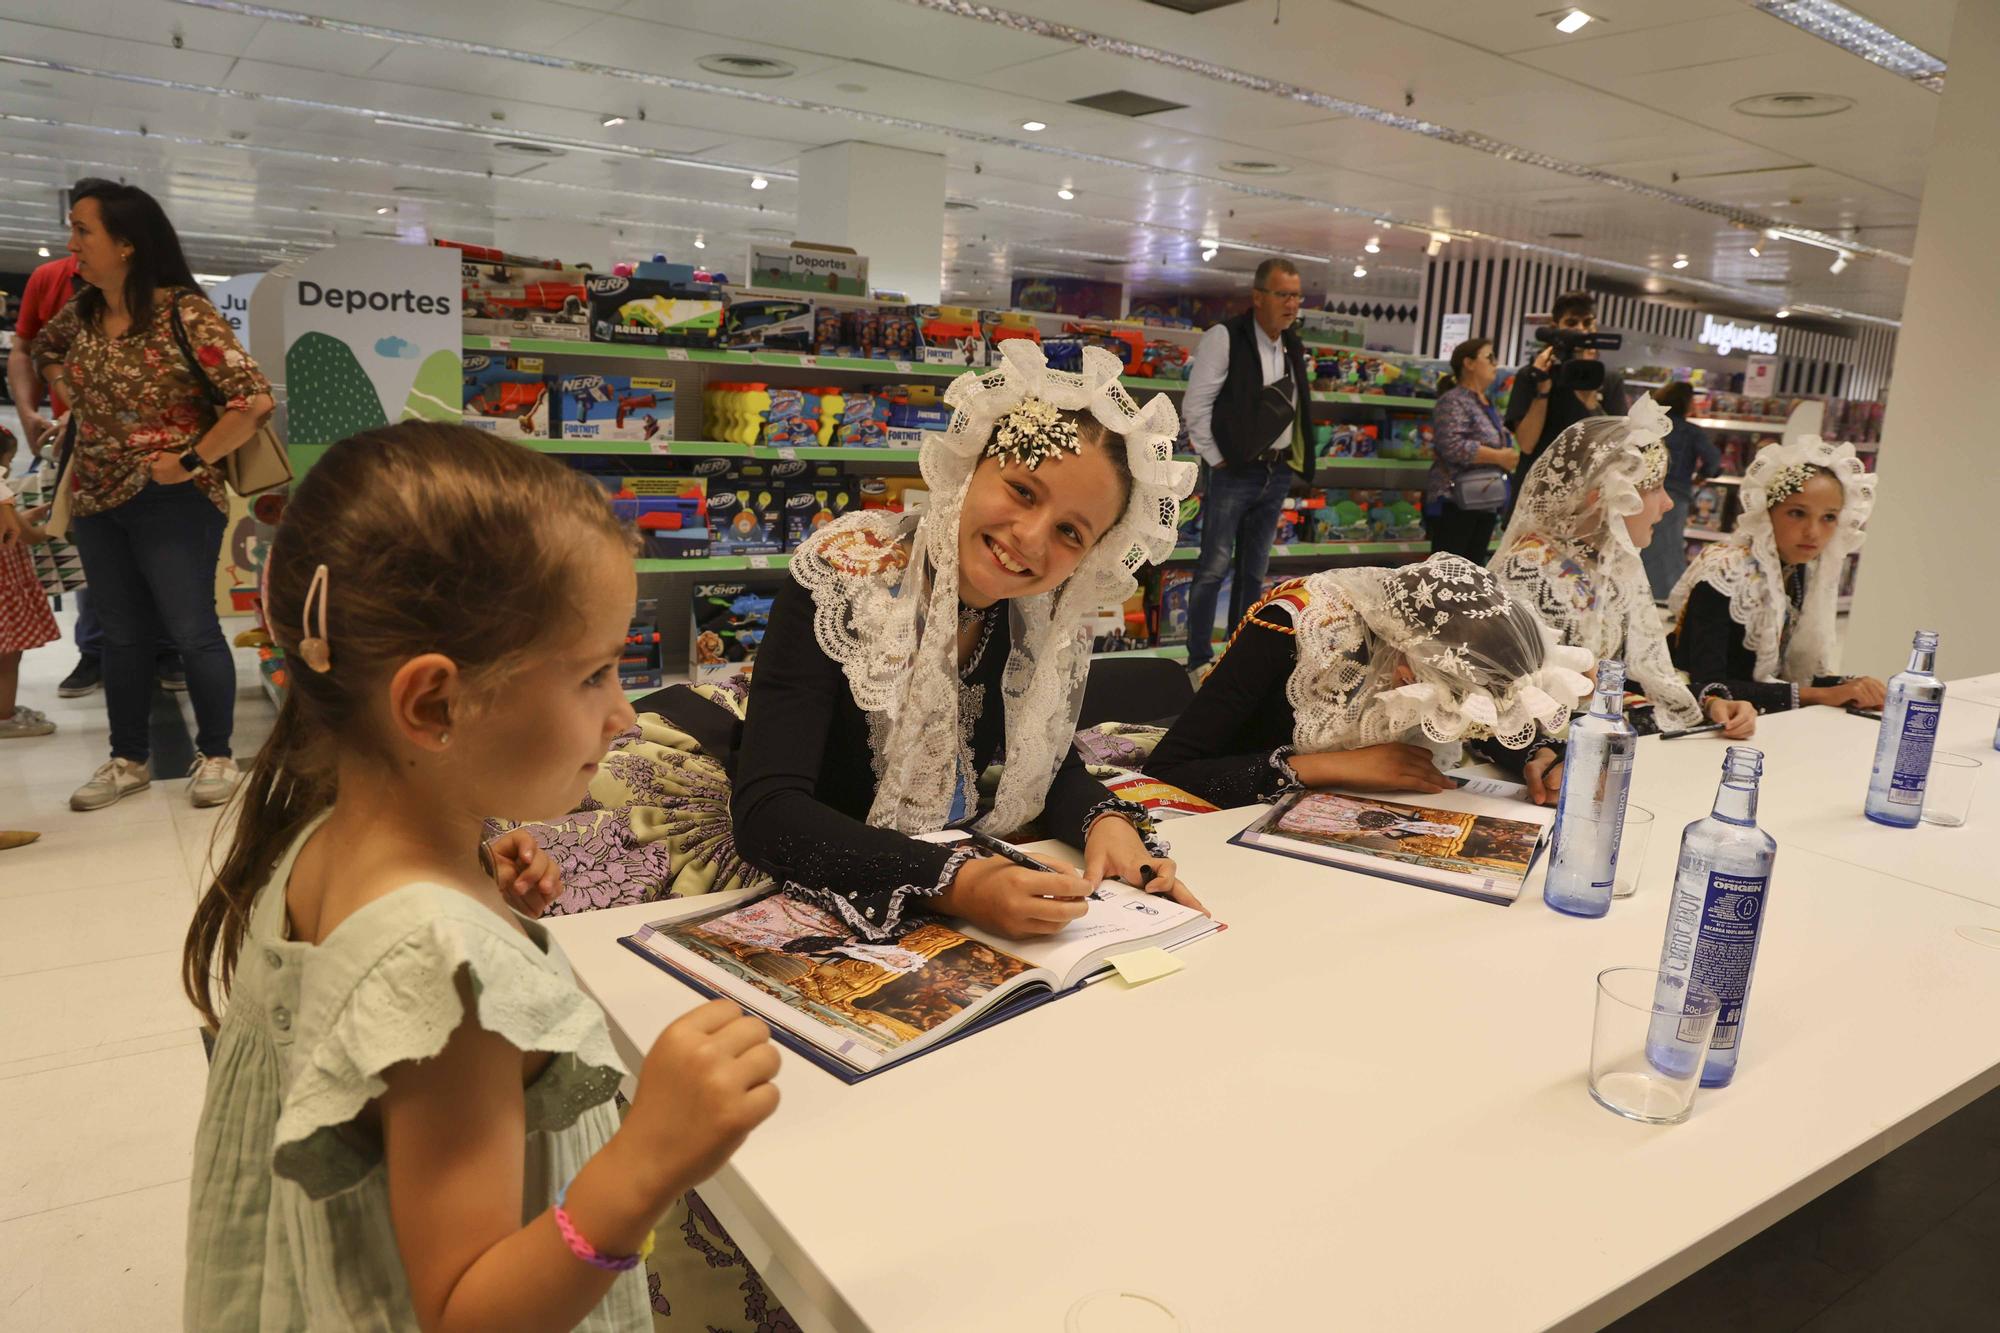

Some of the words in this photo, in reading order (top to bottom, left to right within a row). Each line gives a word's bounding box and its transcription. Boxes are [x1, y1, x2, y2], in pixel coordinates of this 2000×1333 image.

[796, 254, 847, 270] Deportes
[587, 277, 627, 292] NERF
[298, 280, 451, 315] Deportes
[614, 324, 659, 336] ROBLOX
[1698, 314, 1778, 356] Juguetes
[562, 376, 602, 392] NERF
[563, 424, 600, 436] FORTNITE
[888, 430, 922, 441] FORTNITE
[693, 459, 730, 476] NERF
[771, 460, 806, 477] NERF
[707, 493, 736, 508] NERF
[786, 493, 815, 509] NERF
[1713, 880, 1762, 893] ORIGEN
[1684, 1004, 1702, 1016] 50cl
